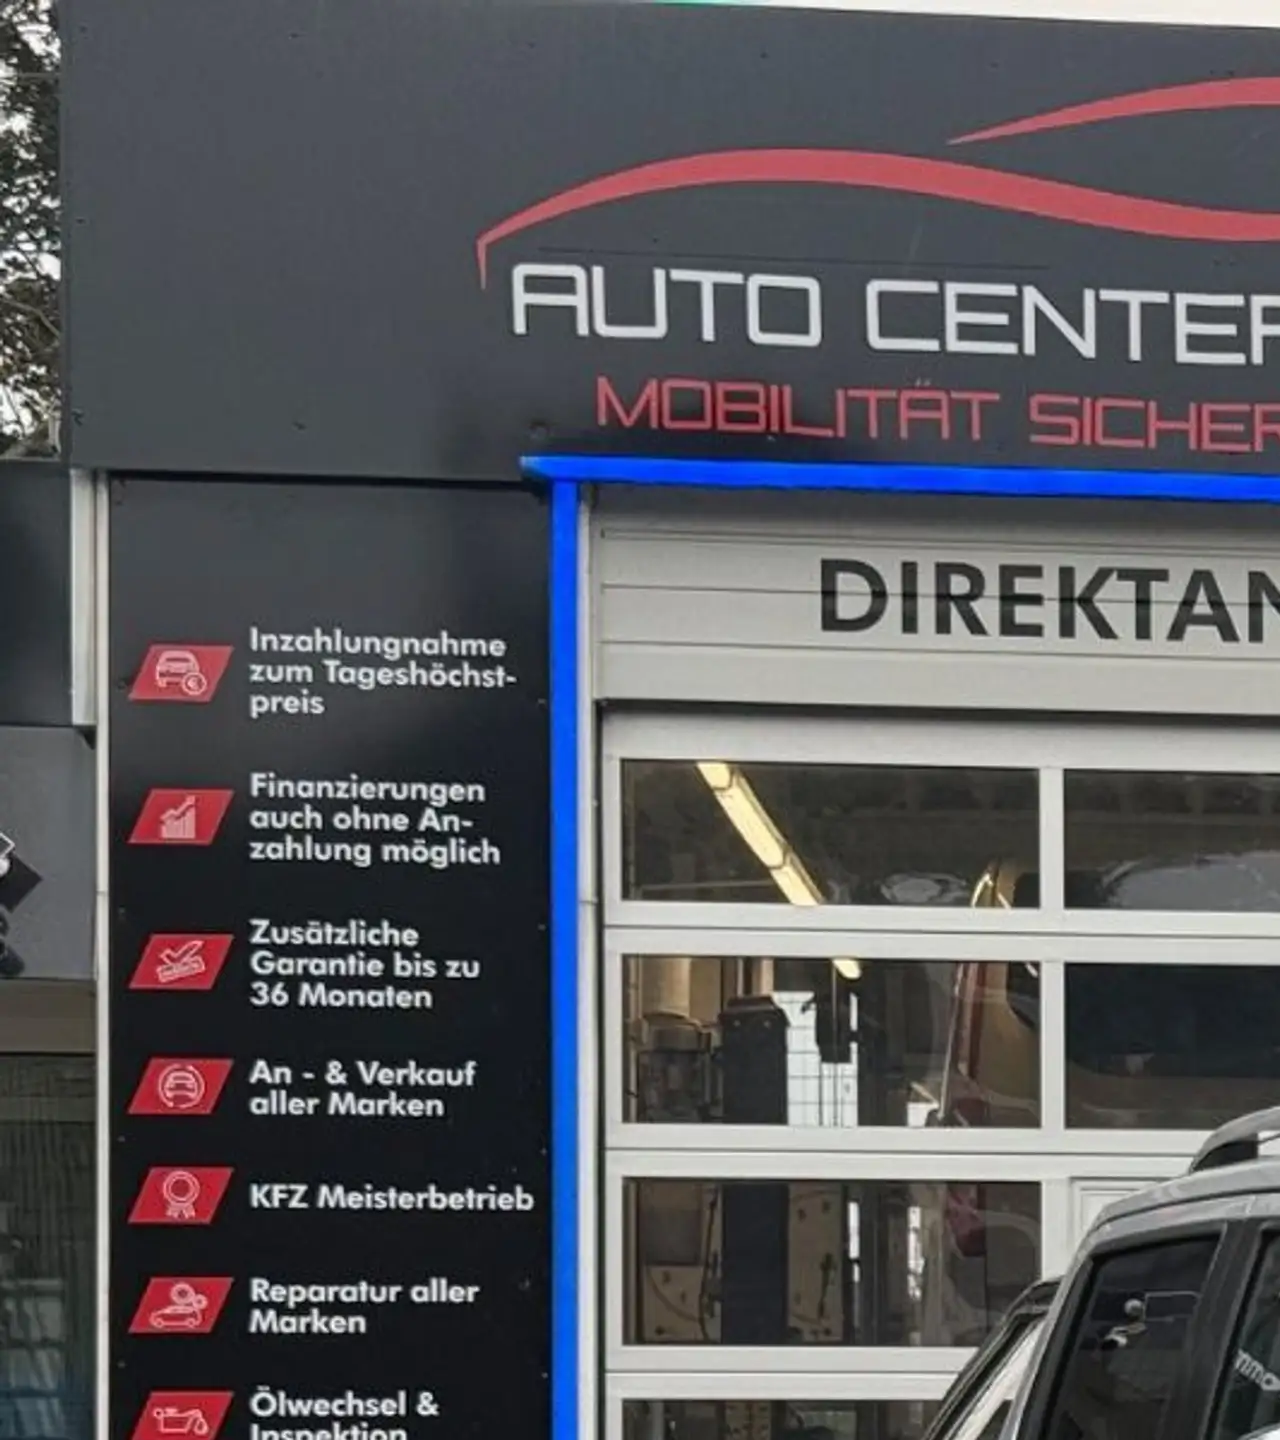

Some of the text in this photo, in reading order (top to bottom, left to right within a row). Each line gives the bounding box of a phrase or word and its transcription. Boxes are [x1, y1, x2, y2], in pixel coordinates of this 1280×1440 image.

[512, 264, 822, 346] AUTO
[596, 376, 1000, 440] MOBILITÄT
[249, 626, 507, 664] Inzahlungnahme
[249, 658, 517, 691] zum Tageshöchst-
[249, 687, 325, 719] preis
[250, 771, 485, 811] Finanzierungen
[249, 803, 473, 833] auch ohne An-
[249, 834, 501, 869] zahlung möglich
[249, 918, 419, 947] Zusätzliche
[250, 950, 480, 978] Garantie bis zu
[250, 981, 432, 1009] 36 Monaten
[249, 1059, 292, 1085] An
[324, 1060, 347, 1085] &
[356, 1060, 477, 1087] Verkauf
[249, 1089, 444, 1117] aller Marken
[250, 1183, 534, 1211] KFZ Meisterbetrieb
[251, 1277, 480, 1309] Reparatur aller
[249, 1307, 366, 1334] Marken
[249, 1385, 439, 1417] Ölwechsel &
